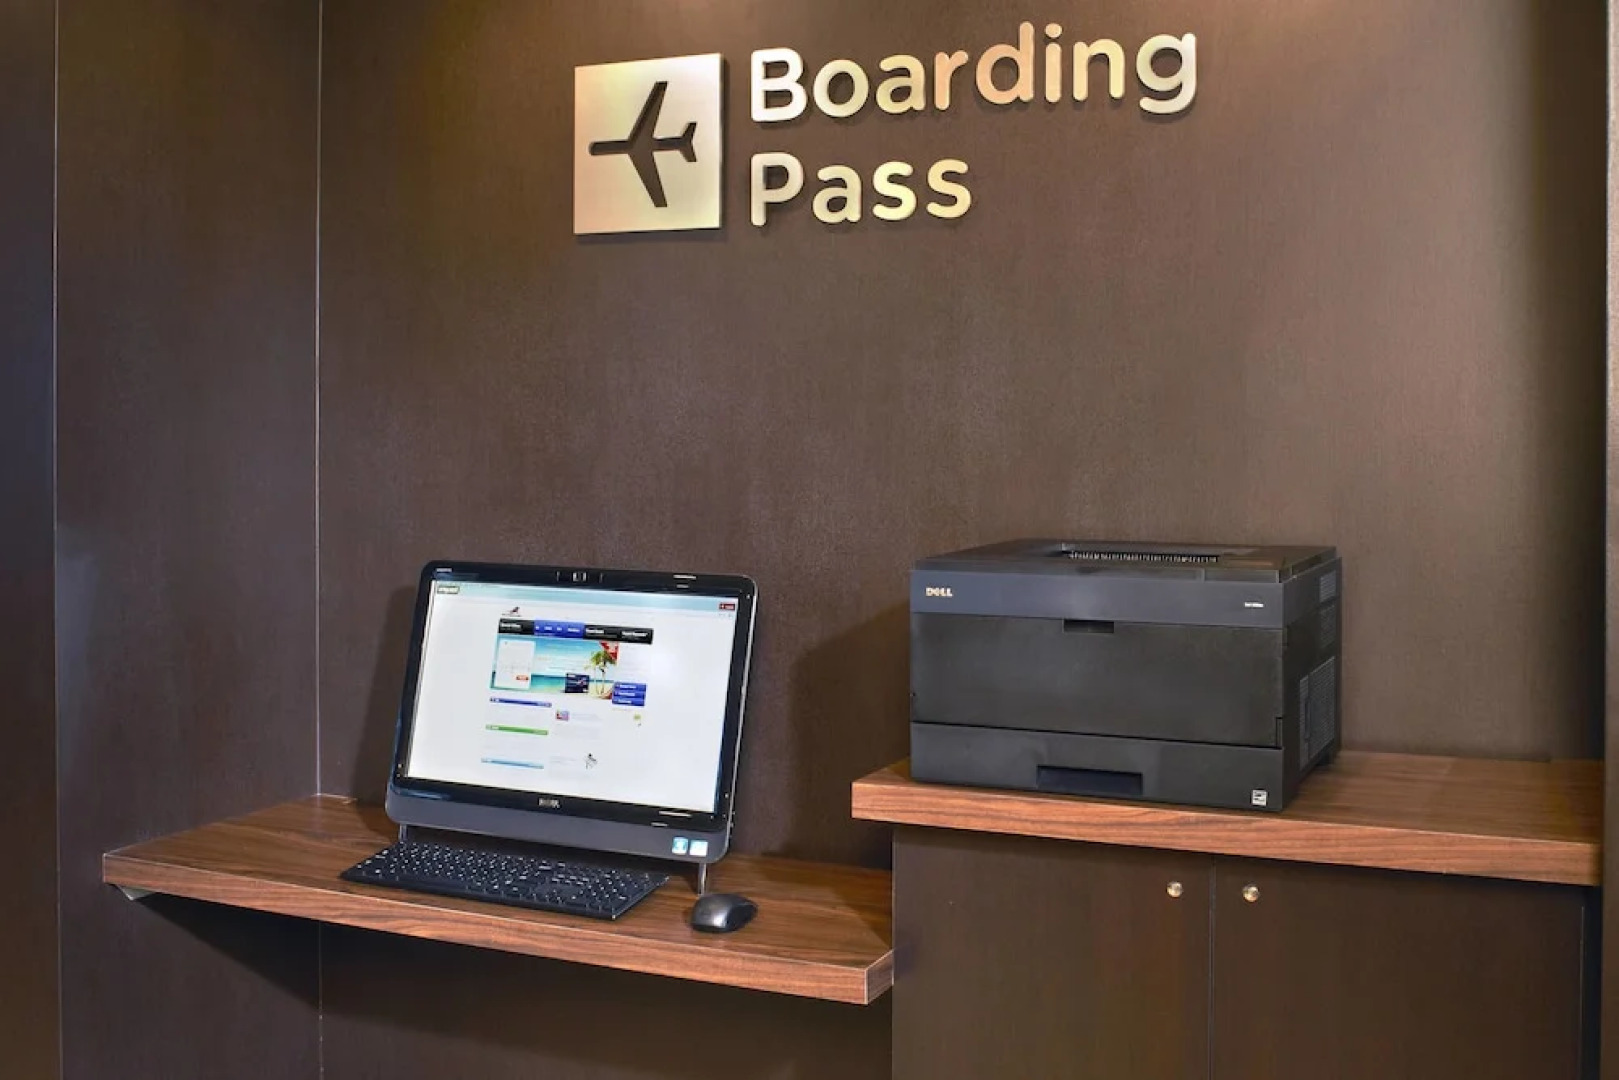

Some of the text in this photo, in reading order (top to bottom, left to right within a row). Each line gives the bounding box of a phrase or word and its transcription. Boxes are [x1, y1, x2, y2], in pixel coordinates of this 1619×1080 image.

[751, 22, 1197, 122] Boarding
[751, 152, 972, 226] Pass
[926, 587, 953, 597] DELL
